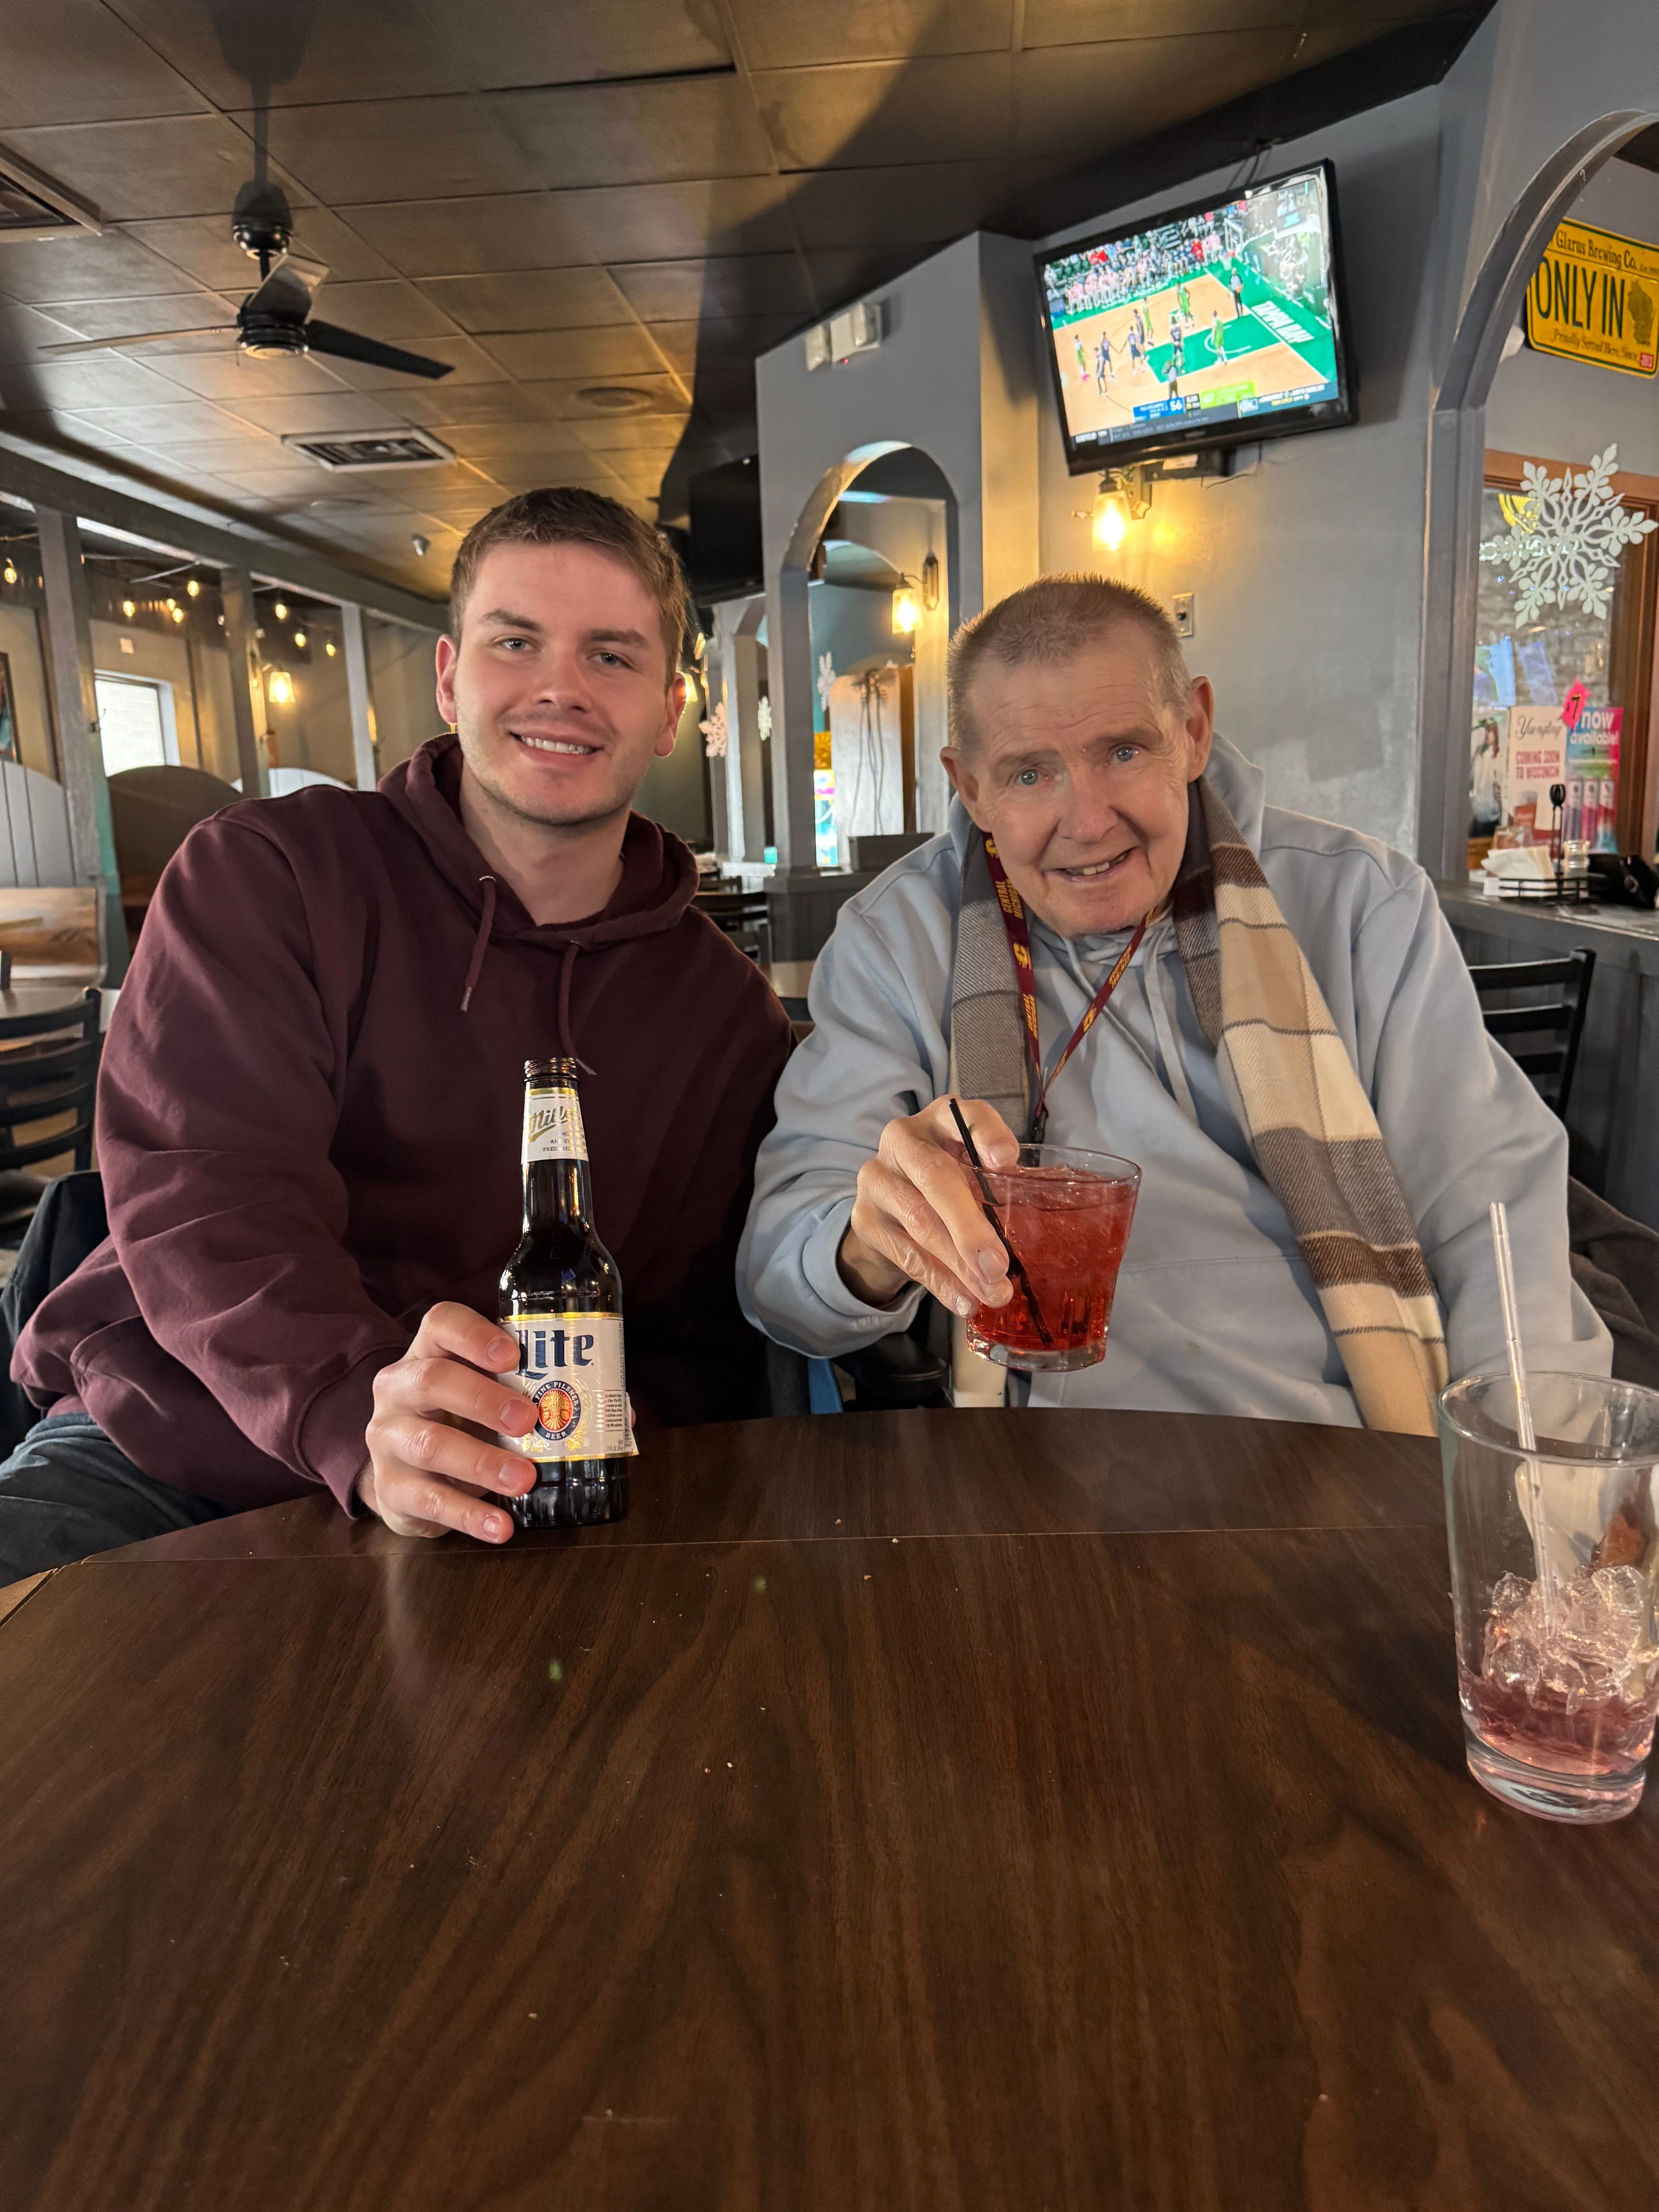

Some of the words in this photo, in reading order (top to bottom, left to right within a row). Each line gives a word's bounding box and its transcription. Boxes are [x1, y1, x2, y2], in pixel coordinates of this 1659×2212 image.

[1556, 230, 1586, 255] Glarus
[1588, 239, 1621, 270] Brewing
[1535, 256, 1596, 330] ONLY
[1602, 273, 1625, 339] IN
[1169, 398, 1182, 412] 56
[1580, 711, 1614, 730] now
[995, 881, 1013, 914] CENTRAL
[515, 1329, 594, 1380] Lite
[535, 1383, 551, 1401] FINE
[554, 1381, 579, 1406] PILSNER
[545, 1431, 568, 1439] BEER
